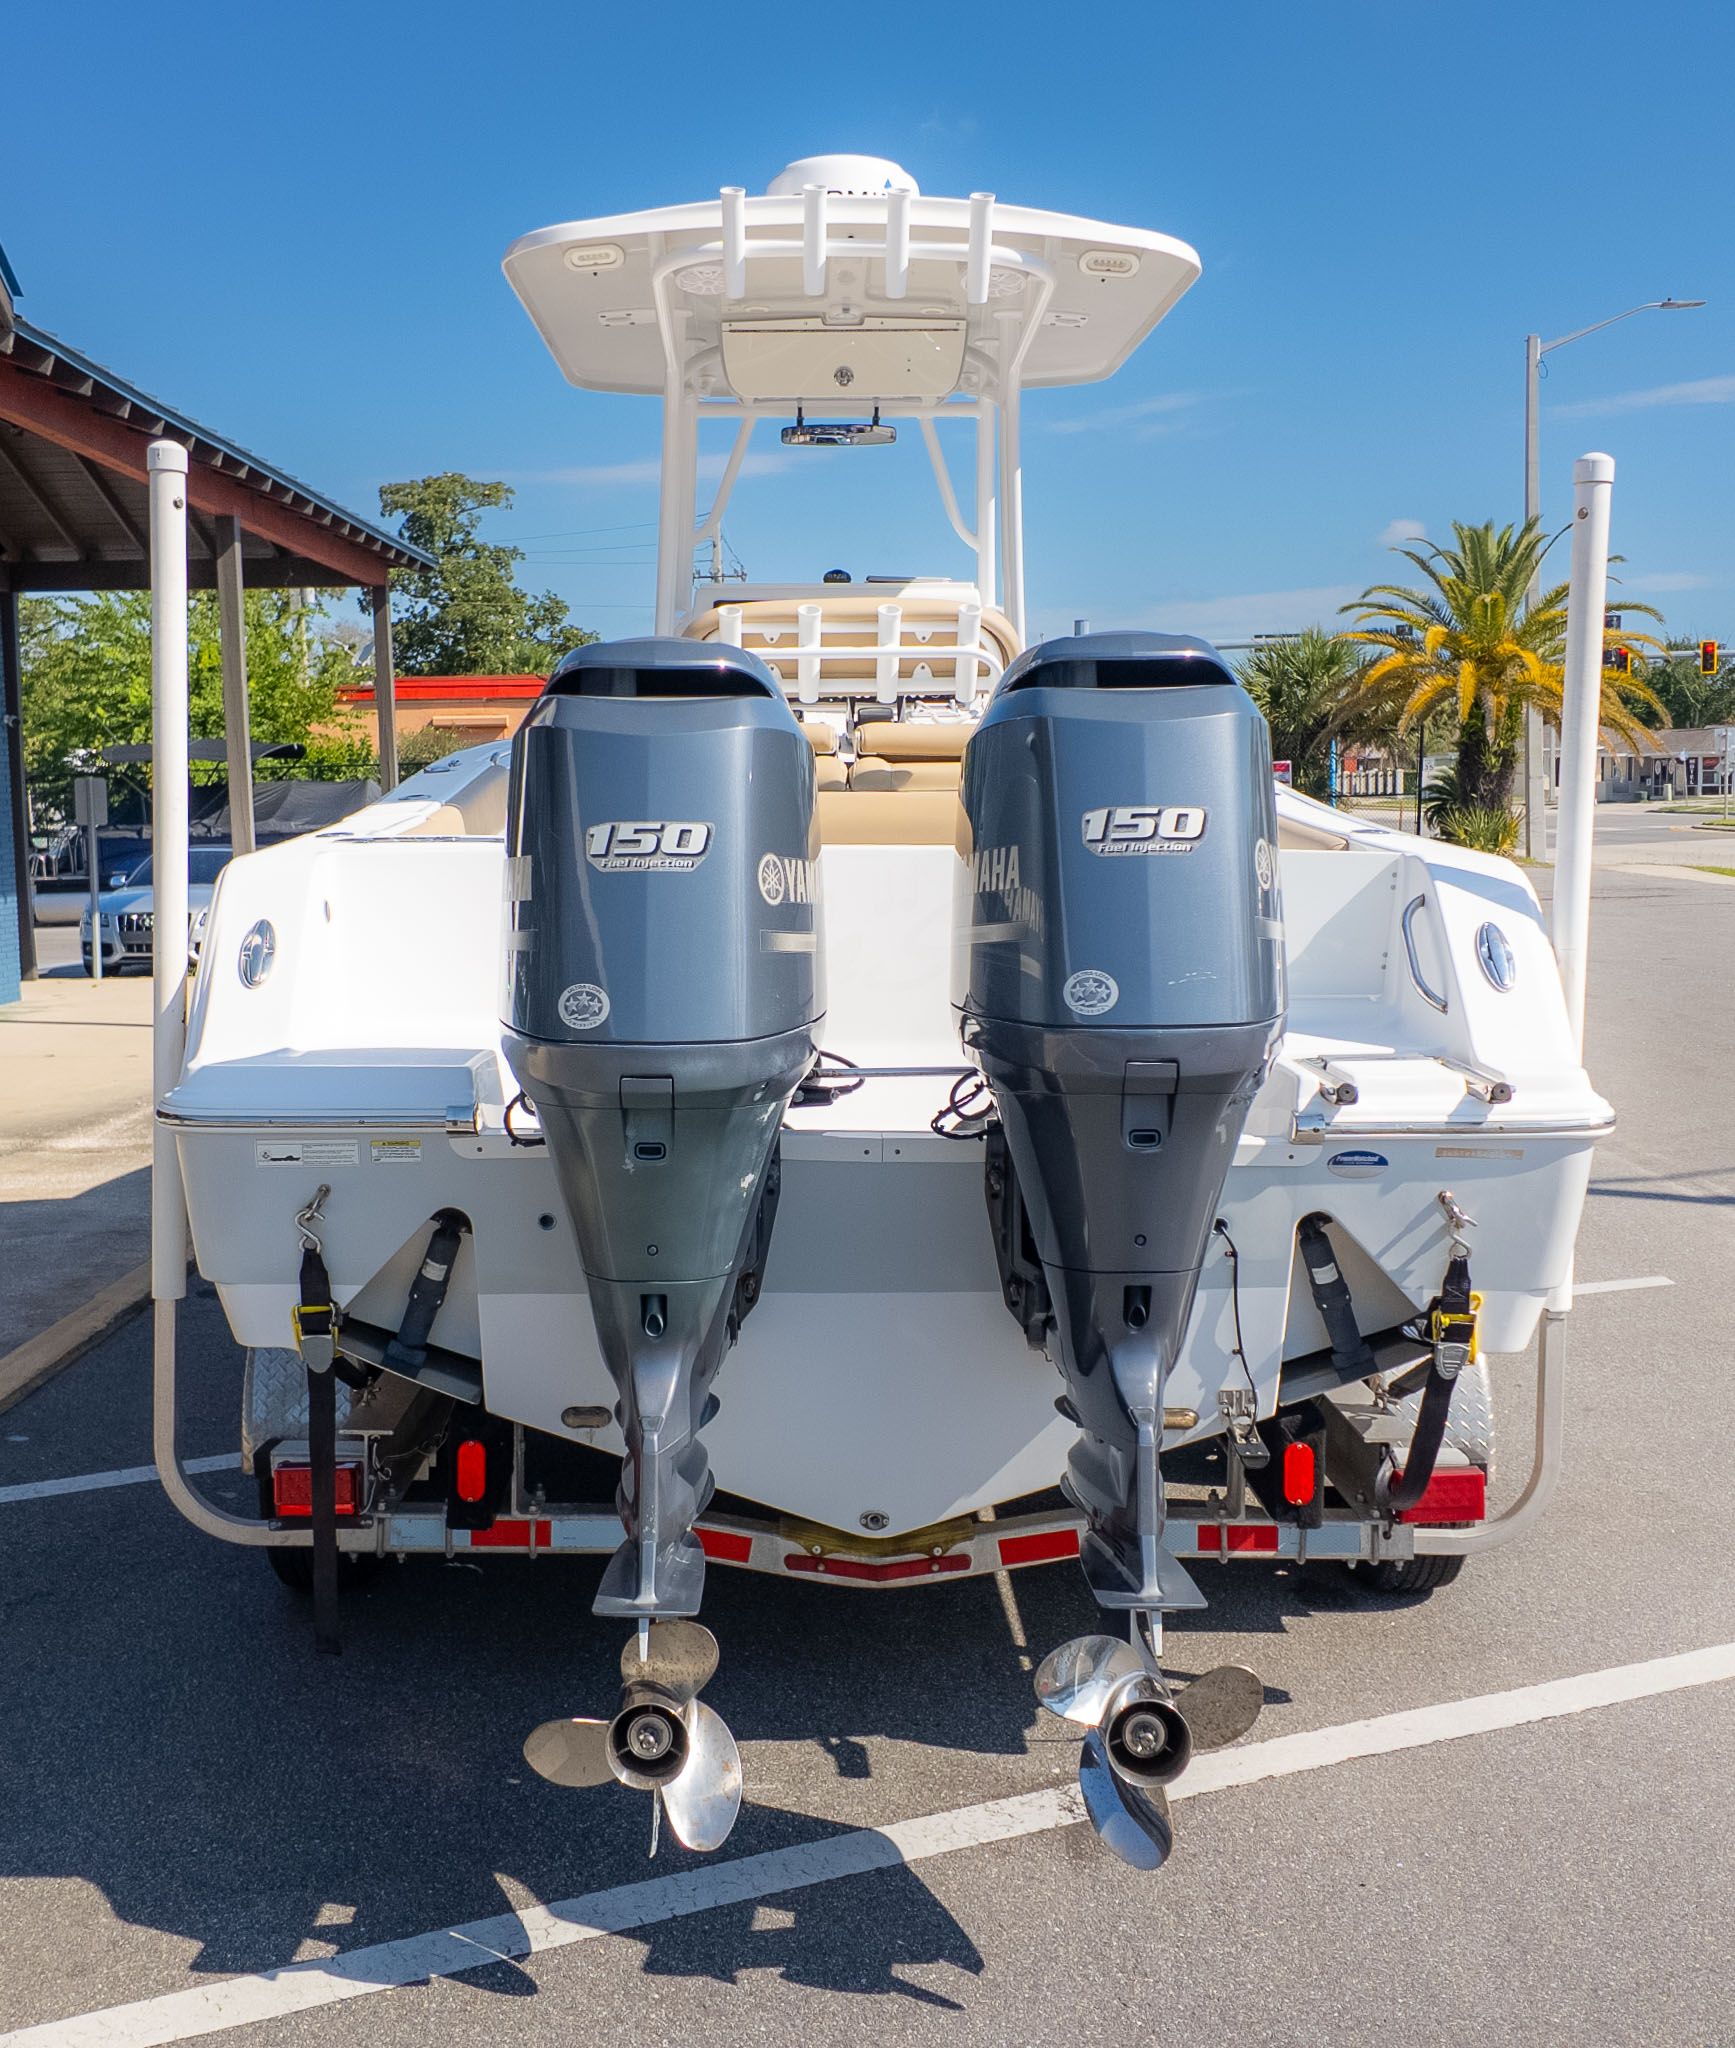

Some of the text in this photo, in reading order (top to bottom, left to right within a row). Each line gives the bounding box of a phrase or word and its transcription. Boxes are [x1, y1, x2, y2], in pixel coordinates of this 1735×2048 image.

[1085, 807, 1206, 840] 150
[589, 823, 709, 856] 150
[1097, 843, 1192, 854] Fuel Injection
[601, 858, 694, 869] Fuel Injection
